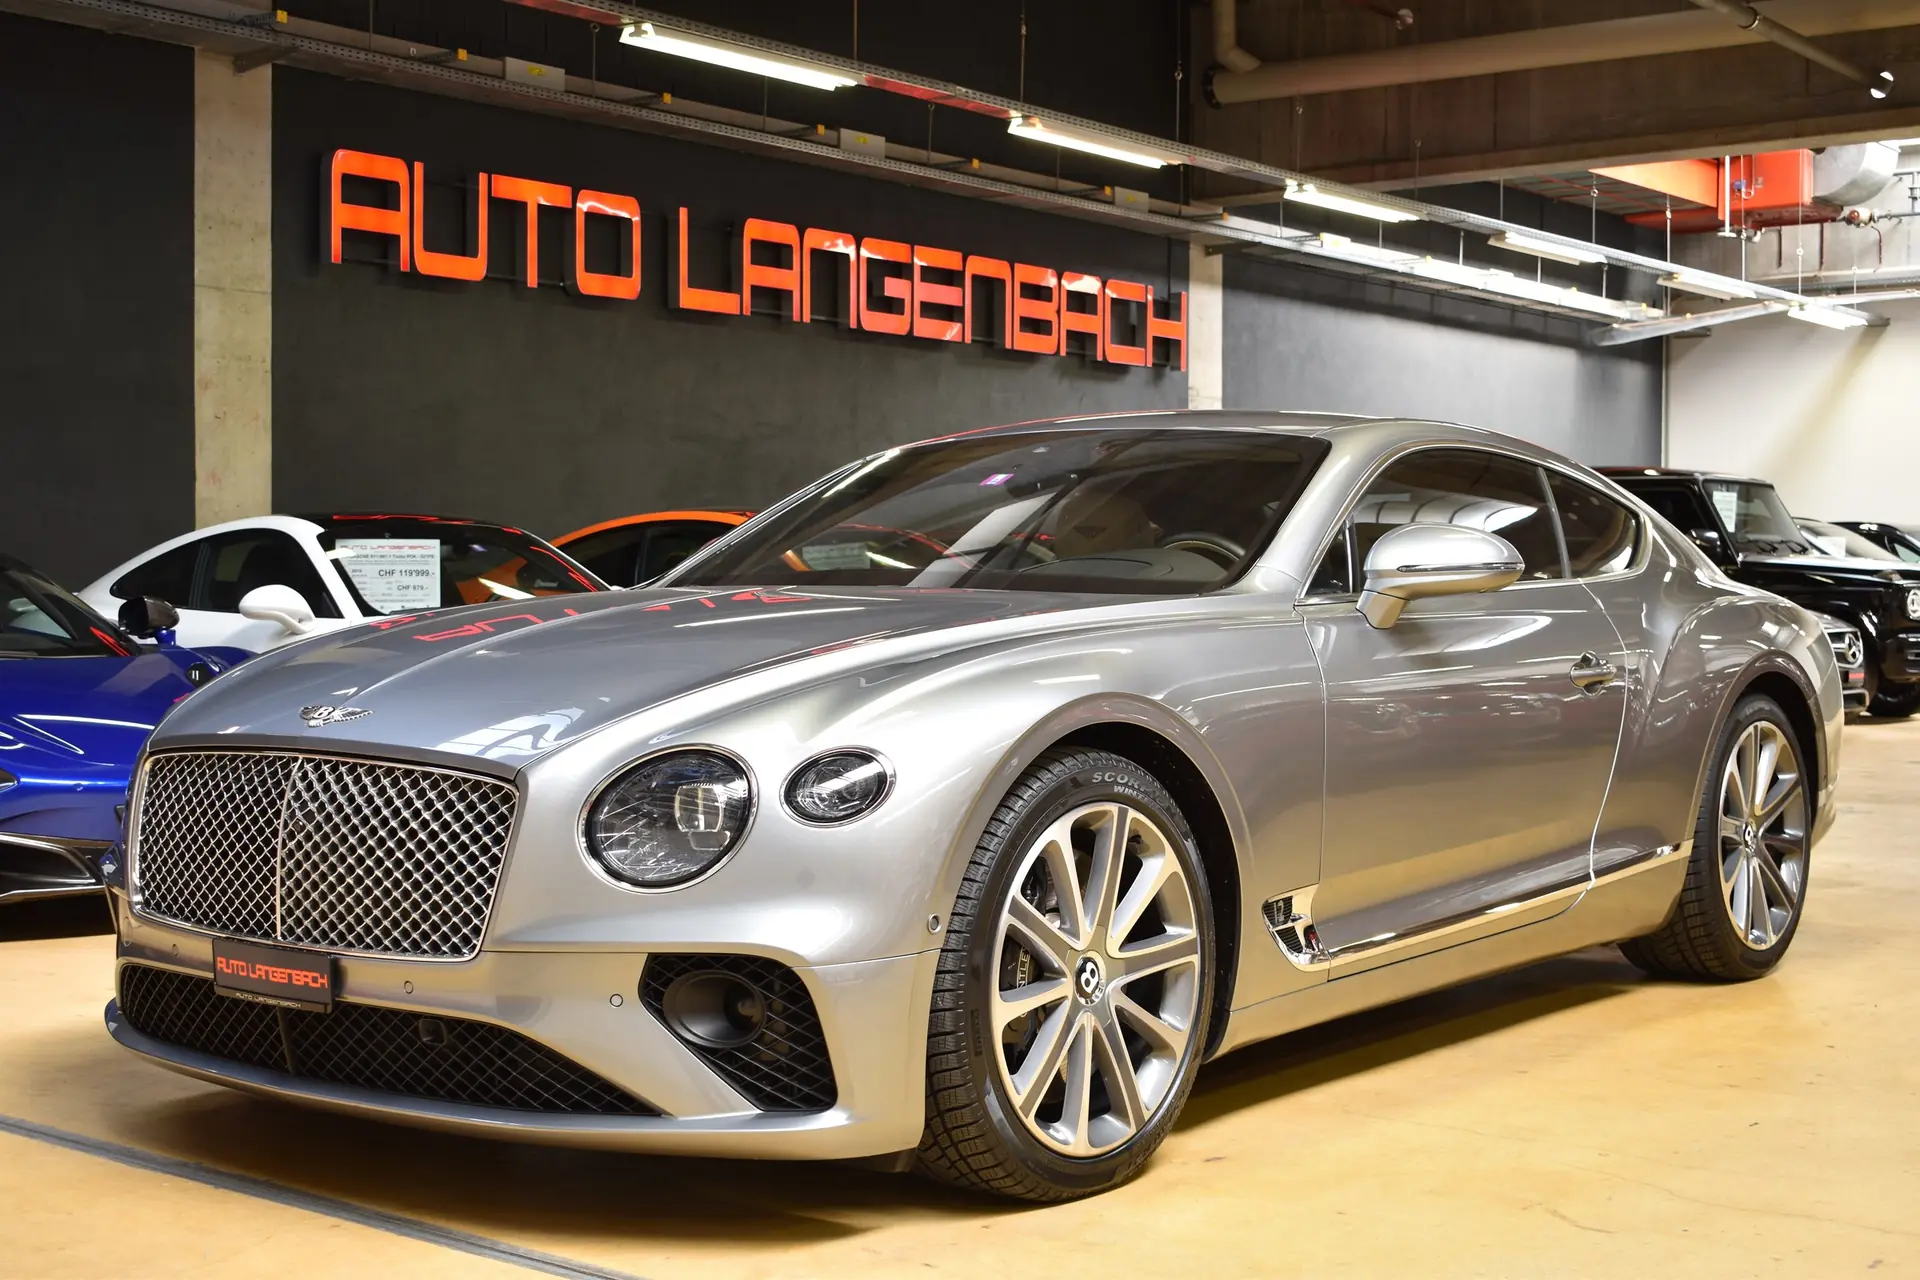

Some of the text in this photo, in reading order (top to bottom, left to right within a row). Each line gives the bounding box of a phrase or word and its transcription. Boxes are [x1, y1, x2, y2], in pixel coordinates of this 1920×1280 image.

[329, 148, 1188, 372] AUTO LANGENBACH
[378, 569, 397, 577] CHF
[216, 956, 329, 988] AUTO LANGENBACH
[235, 992, 302, 1008] AUTO LANGENBACH
